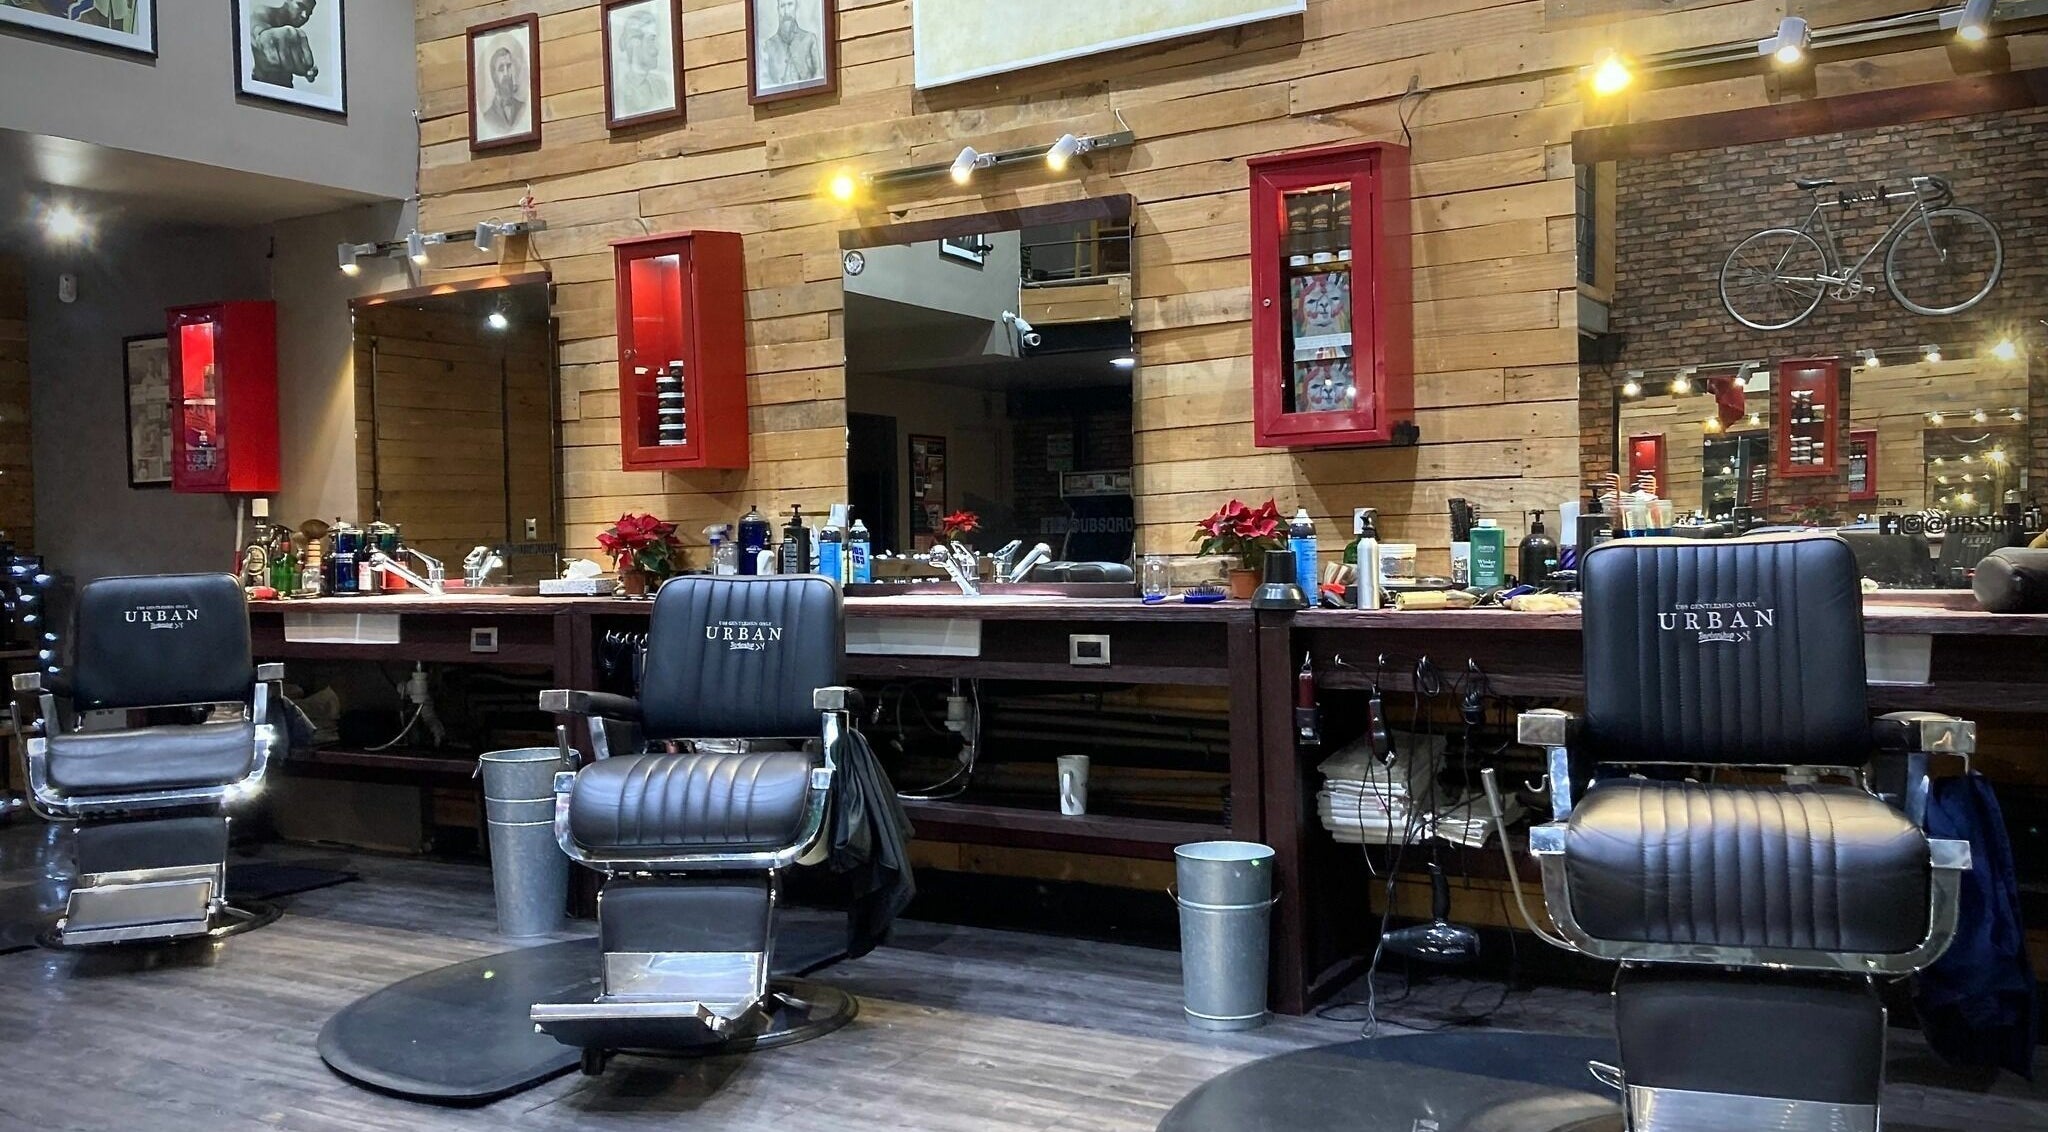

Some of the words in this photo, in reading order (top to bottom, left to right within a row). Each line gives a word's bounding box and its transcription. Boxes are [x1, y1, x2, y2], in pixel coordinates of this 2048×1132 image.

[1736, 600, 1758, 608] ONLY
[124, 609, 199, 623] URBAN
[1657, 608, 1775, 631] URBAN
[706, 625, 783, 641] URBAN
